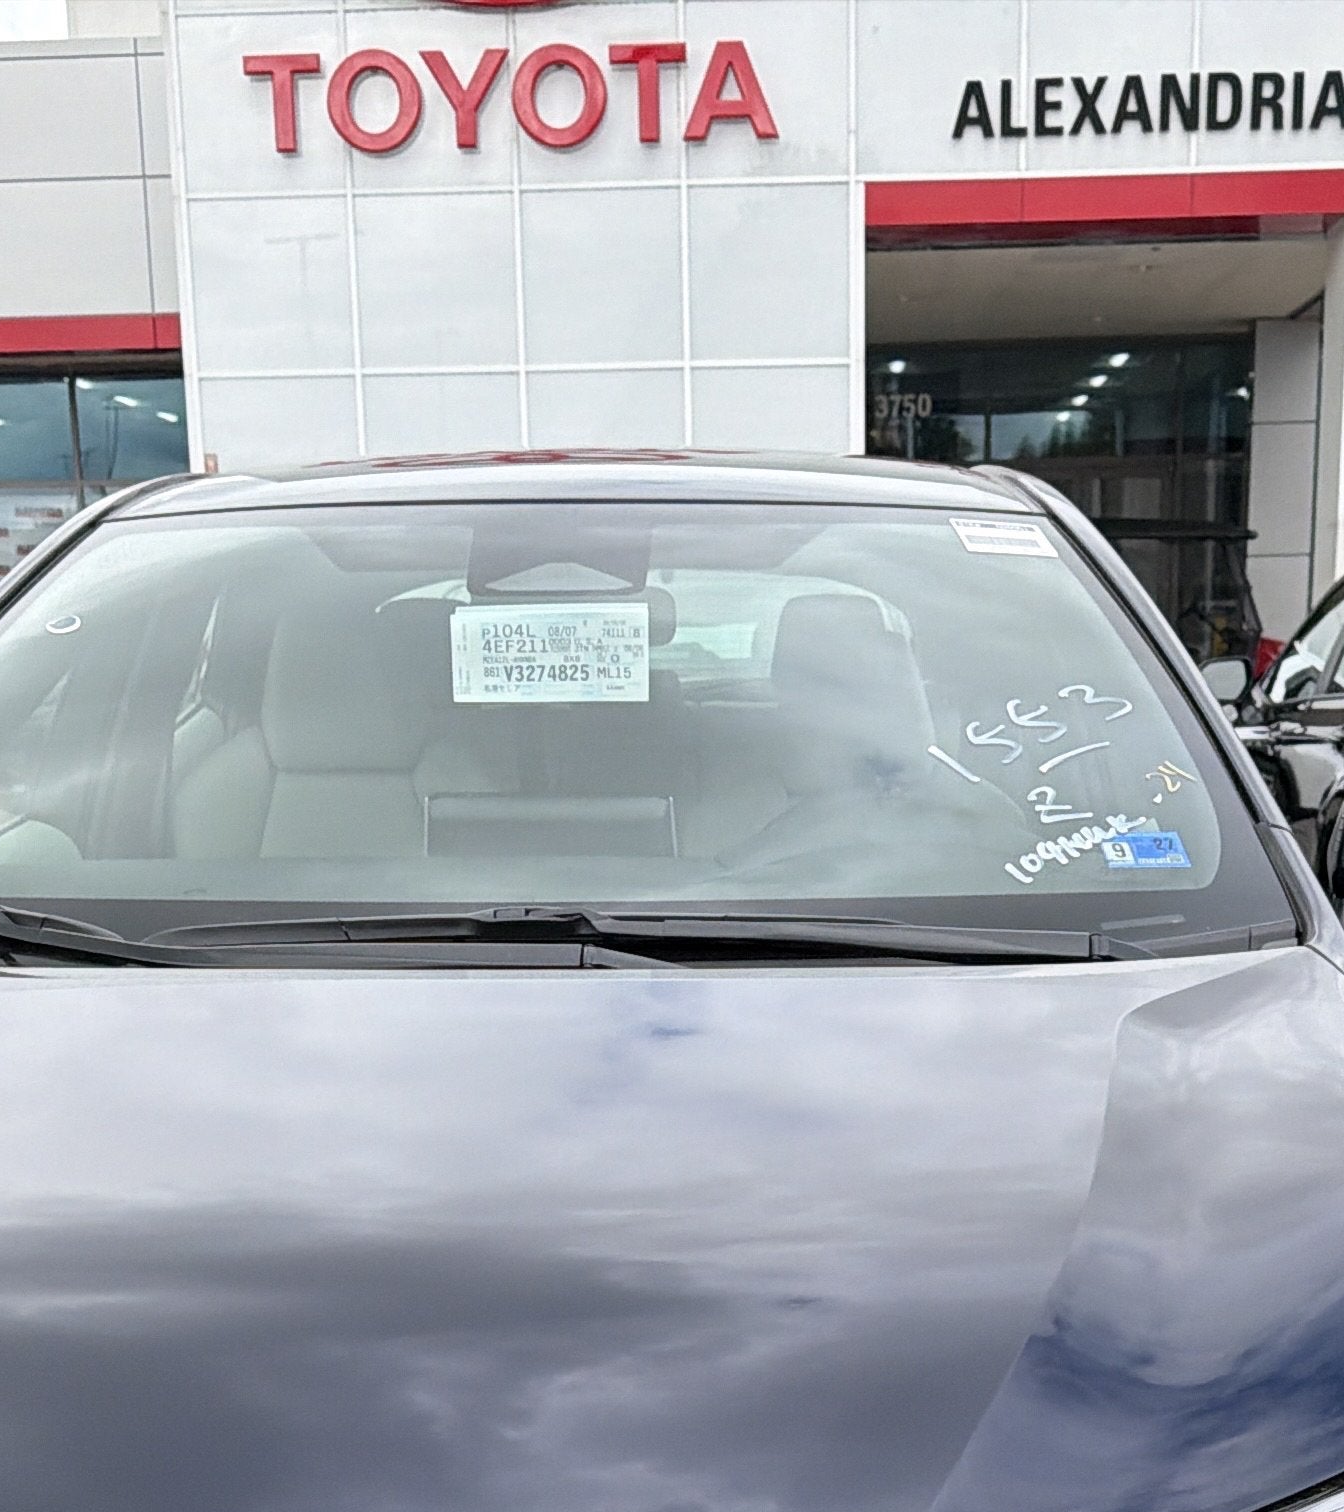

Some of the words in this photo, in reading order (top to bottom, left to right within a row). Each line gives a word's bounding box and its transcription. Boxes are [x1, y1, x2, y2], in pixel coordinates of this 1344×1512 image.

[242, 40, 780, 155] TOYOTA
[874, 392, 933, 419] 3750
[481, 639, 549, 654] 4EF211
[503, 664, 591, 682] V3274825
[596, 666, 632, 679] ML15
[927, 684, 1133, 784] 1553
[1110, 842, 1128, 859] 9
